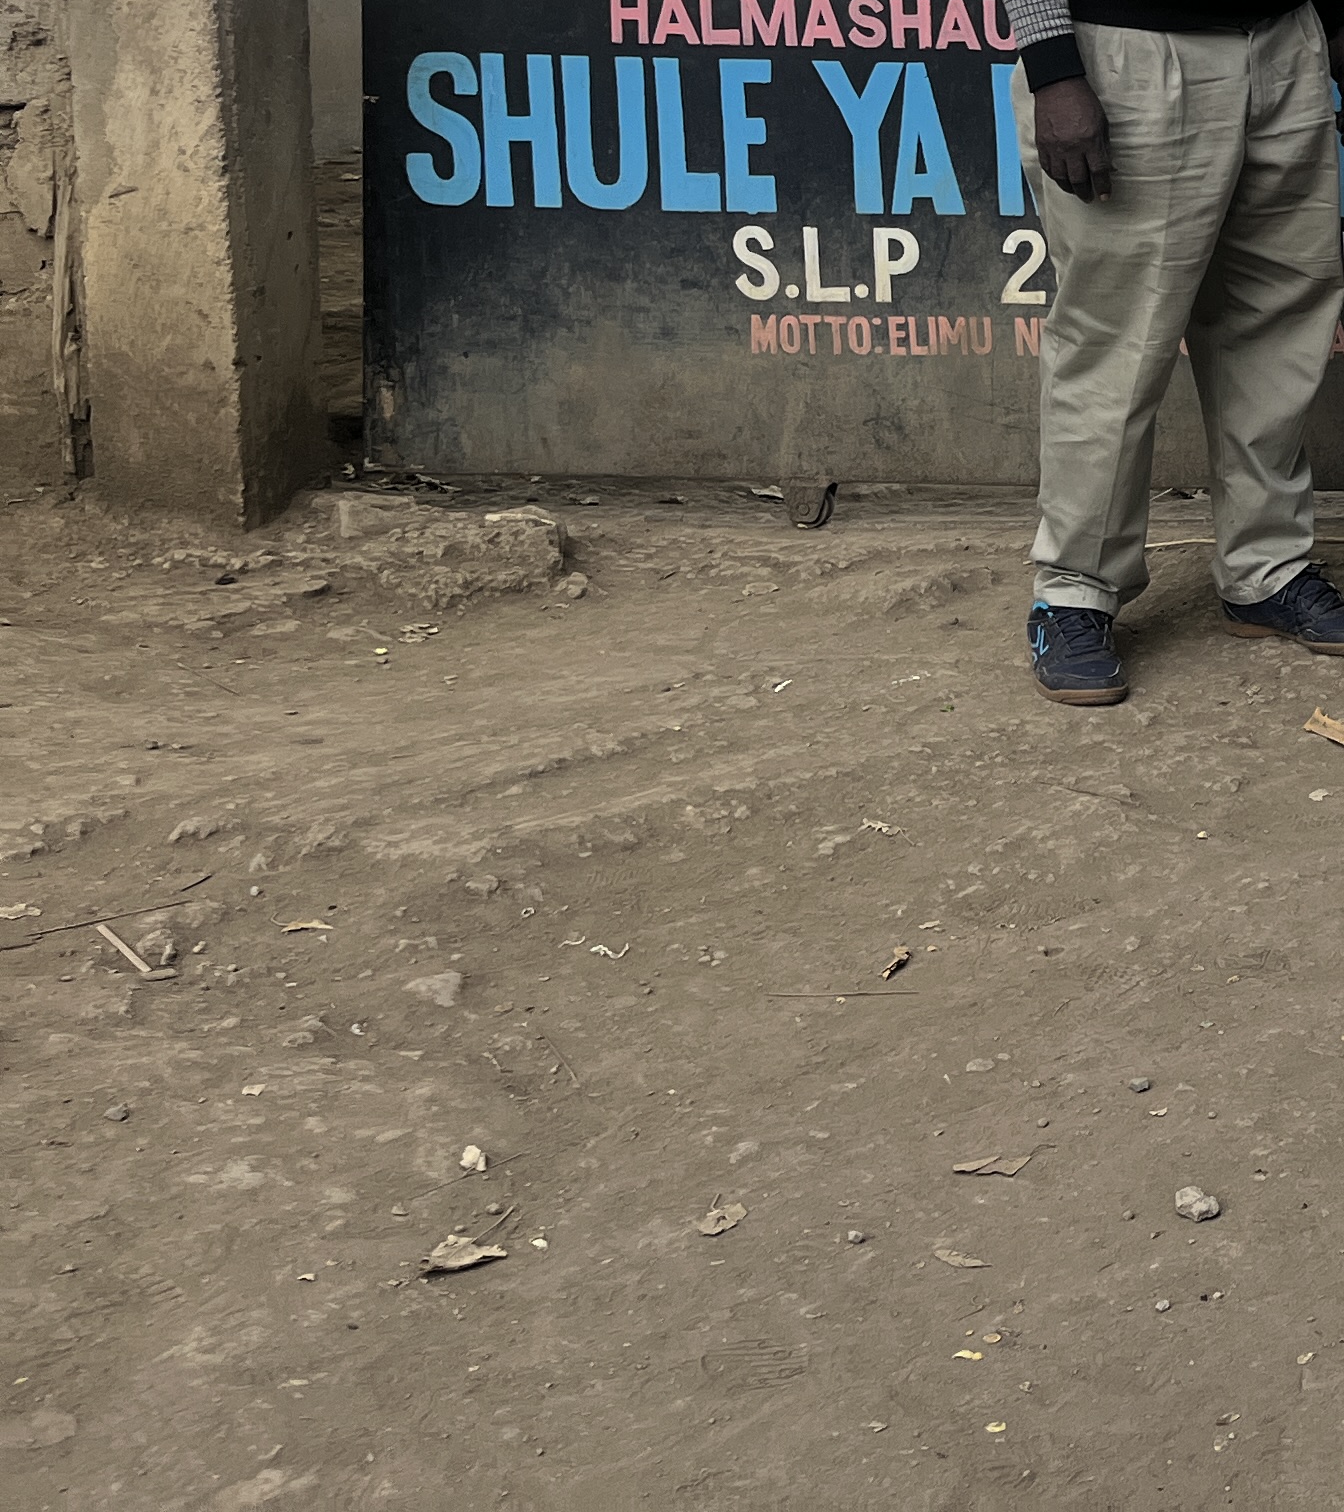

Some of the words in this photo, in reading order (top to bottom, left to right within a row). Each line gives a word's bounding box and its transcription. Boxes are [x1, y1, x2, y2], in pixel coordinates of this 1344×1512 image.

[404, 50, 779, 215] SHULE
[811, 59, 968, 217] YA
[731, 224, 922, 306] S.L.P
